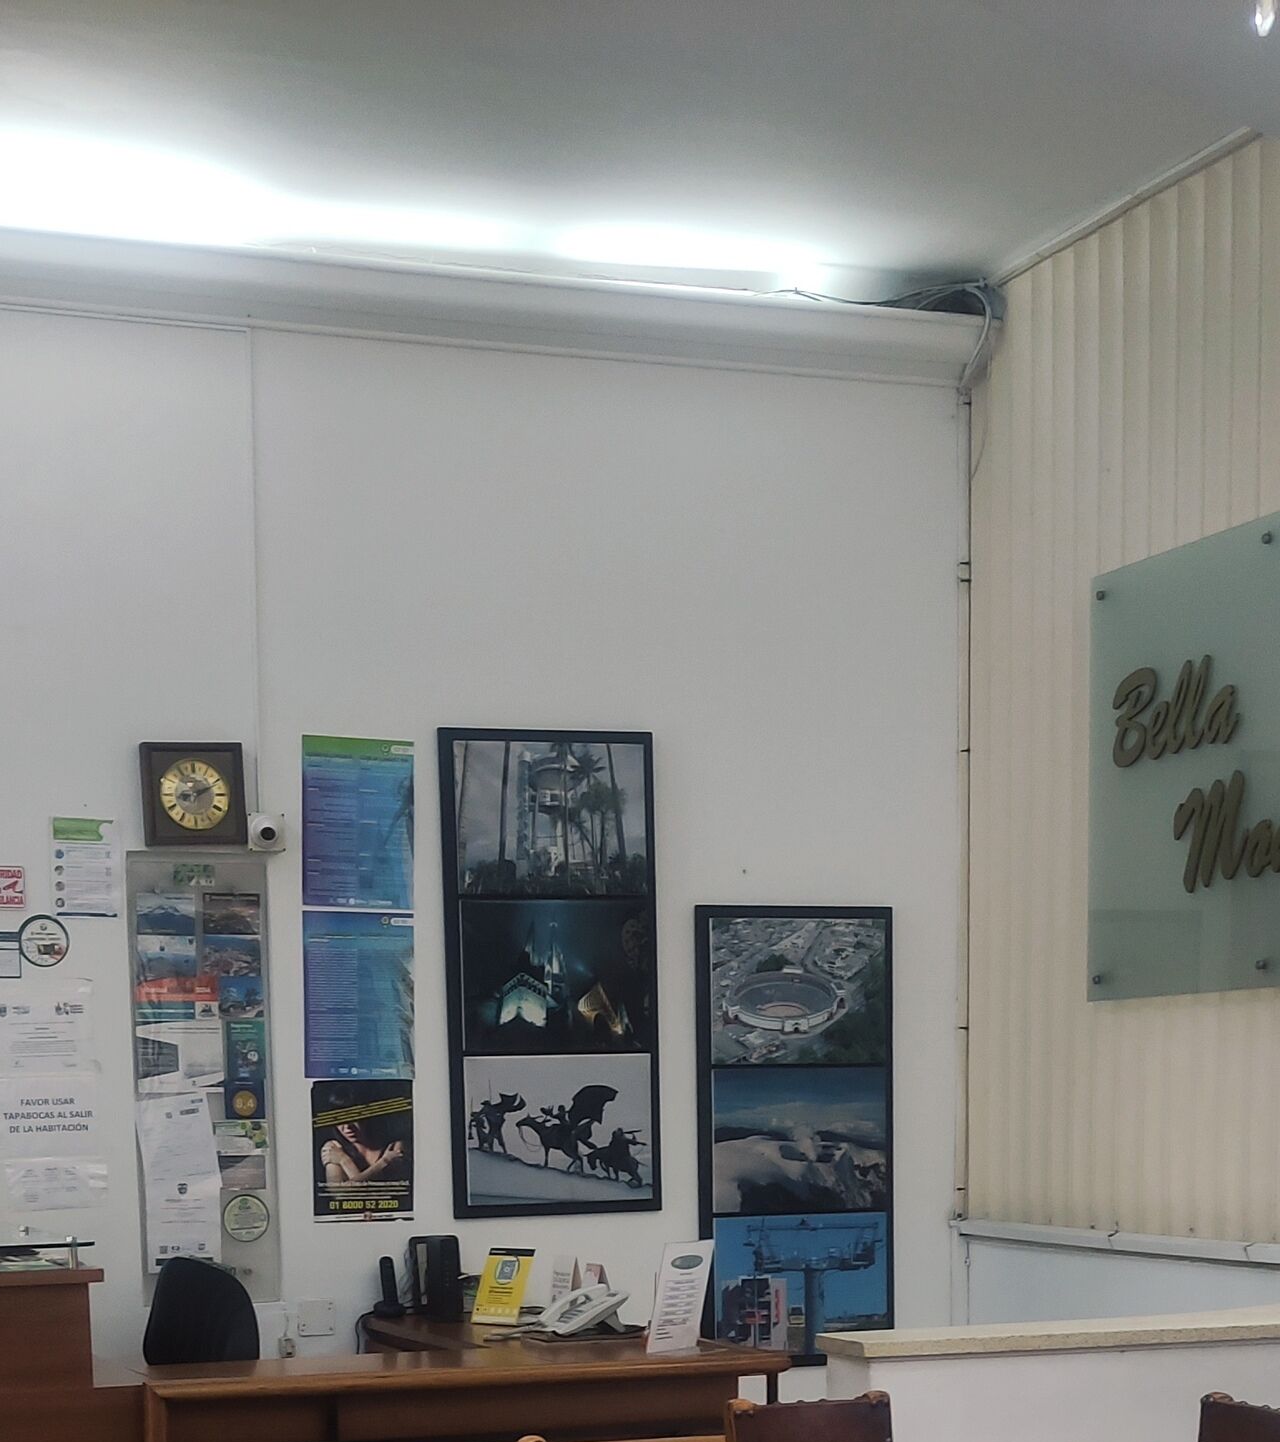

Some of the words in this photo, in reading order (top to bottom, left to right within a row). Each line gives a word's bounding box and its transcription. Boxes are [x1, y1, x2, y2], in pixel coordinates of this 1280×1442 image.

[1112, 654, 1240, 768] Bella
[20, 1098, 49, 1106] FAVOR
[52, 1097, 75, 1105] USAR
[3, 1111, 54, 1120] TAPABOCAS
[57, 1111, 68, 1119] AL
[69, 1110, 93, 1119] SALIR
[9, 1125, 21, 1133] DE
[23, 1125, 33, 1133] LA
[35, 1123, 89, 1132] HABITACIÓN
[329, 1201, 340, 1209] 01
[365, 1200, 376, 1209] 52
[378, 1200, 399, 1209] 2020
